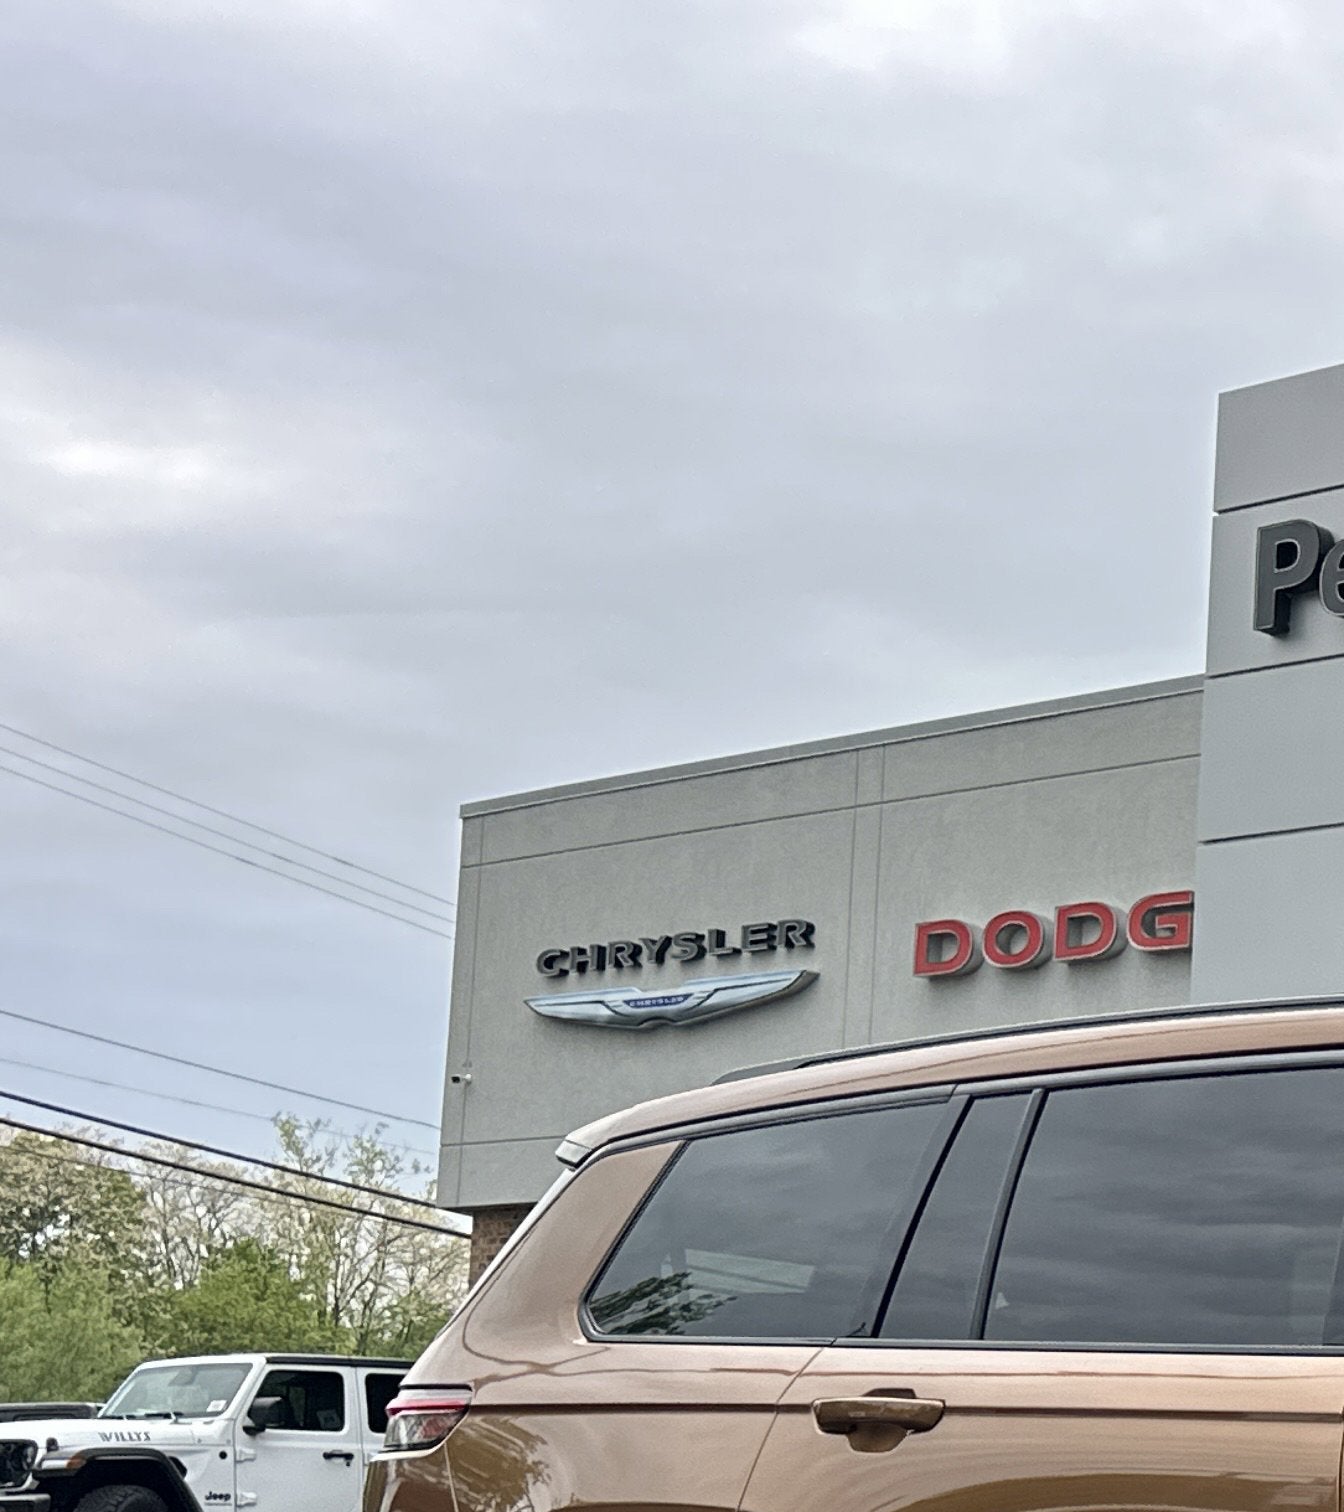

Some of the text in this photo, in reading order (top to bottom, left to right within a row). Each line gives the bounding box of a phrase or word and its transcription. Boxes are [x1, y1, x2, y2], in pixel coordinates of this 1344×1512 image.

[536, 919, 815, 978] CHRYSLER
[98, 1431, 151, 1442] WILLYS
[204, 1491, 232, 1502] Jeep
